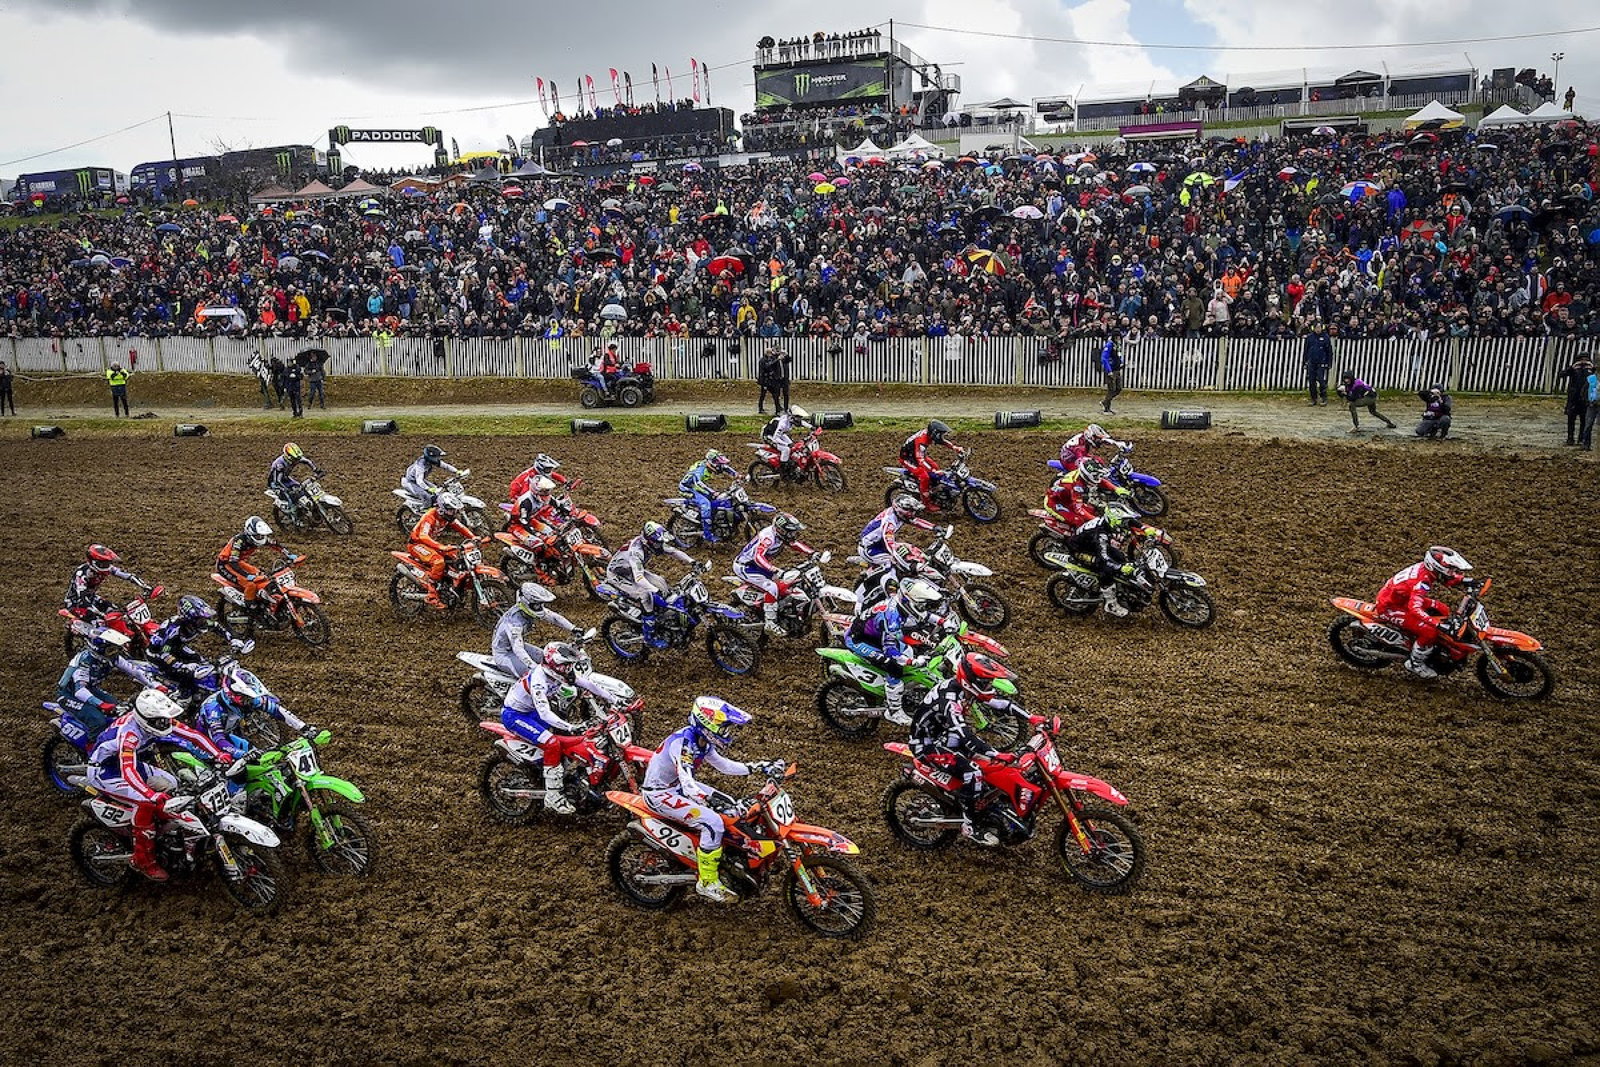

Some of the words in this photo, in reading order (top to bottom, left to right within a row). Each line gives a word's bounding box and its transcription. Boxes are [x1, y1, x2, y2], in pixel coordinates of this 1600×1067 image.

[811, 74, 848, 83] MONSTER
[352, 132, 421, 141] PADDOCK
[694, 584, 707, 601] 10
[135, 607, 149, 623] 70
[628, 606, 642, 618] 10
[857, 670, 878, 684] 3
[61, 723, 86, 740] 517
[615, 725, 628, 743] 24
[516, 743, 537, 758] 24
[299, 754, 314, 773] 41
[211, 787, 232, 812] 132
[100, 805, 124, 825] 132
[776, 796, 793, 825] 96
[659, 826, 682, 848] 96
